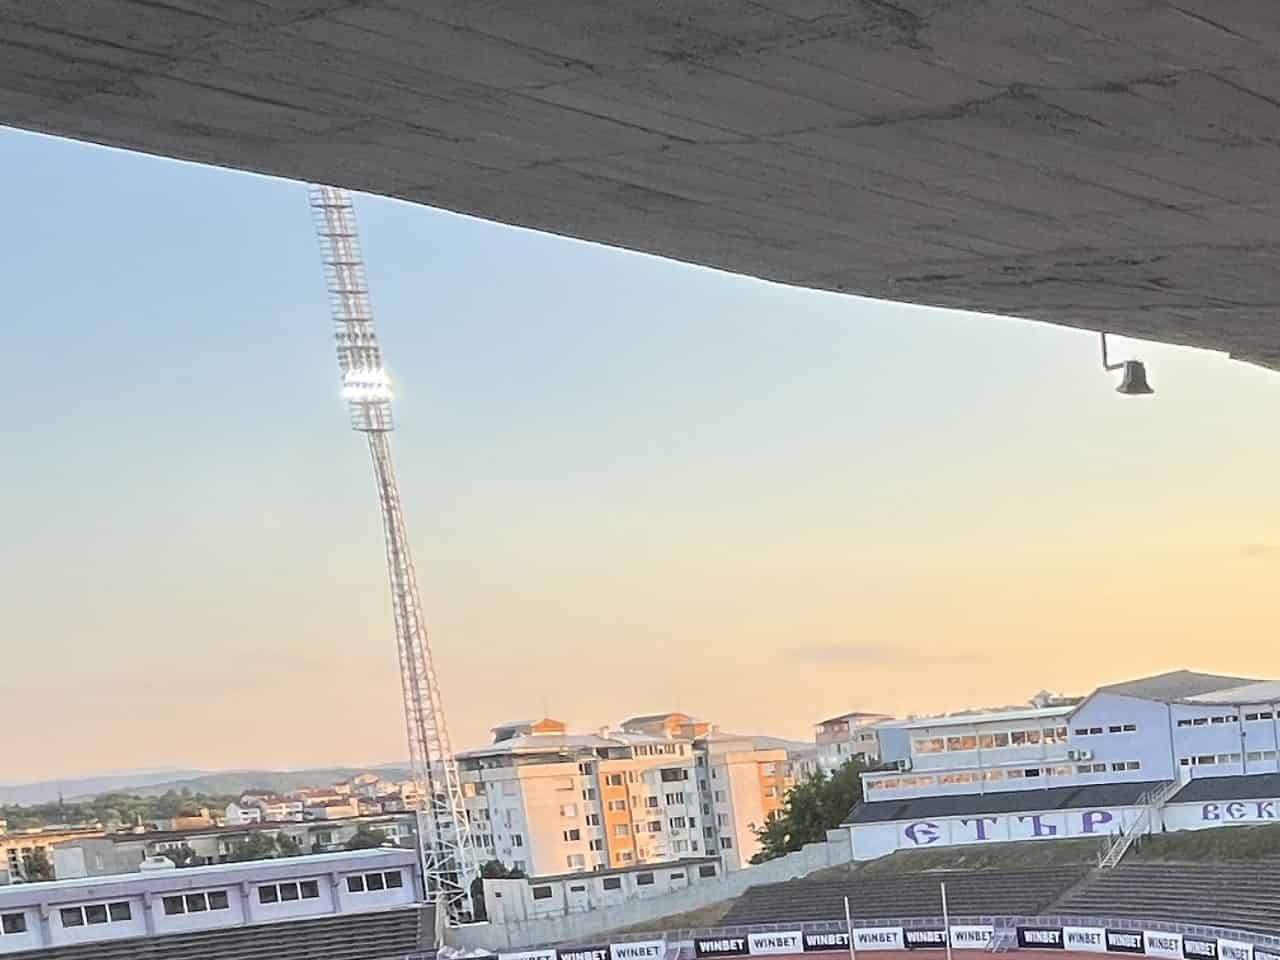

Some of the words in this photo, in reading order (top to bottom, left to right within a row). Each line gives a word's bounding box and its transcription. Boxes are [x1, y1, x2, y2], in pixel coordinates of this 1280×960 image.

[753, 935, 798, 948] WINBET
[806, 933, 850, 946] WINBET
[858, 932, 899, 944] WINBET
[906, 930, 948, 943] WINBET
[955, 930, 994, 942] WINBET
[1068, 932, 1101, 945] WINBET
[616, 945, 660, 959] WINBET
[699, 938, 745, 953] WINBET
